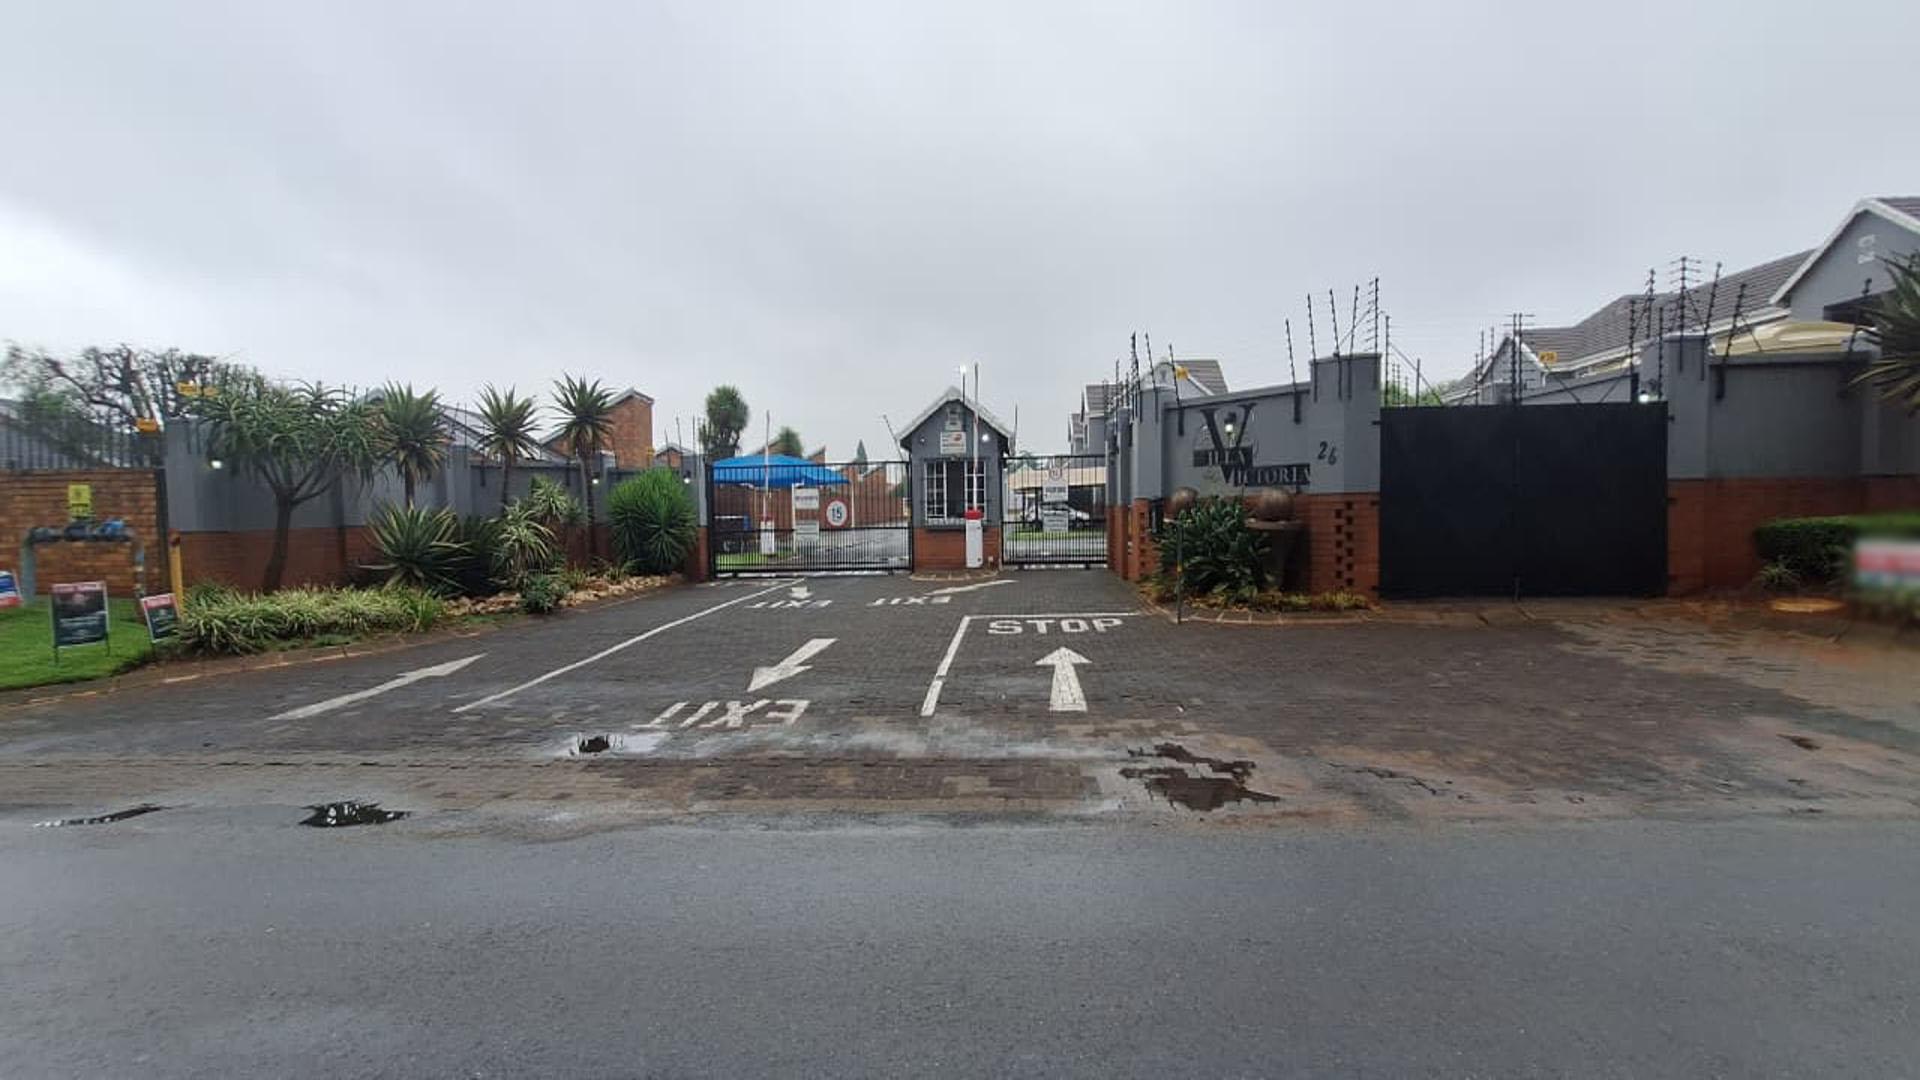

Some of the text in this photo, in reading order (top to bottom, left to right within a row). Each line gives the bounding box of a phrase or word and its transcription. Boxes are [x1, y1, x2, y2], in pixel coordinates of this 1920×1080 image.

[1317, 441, 1337, 466] 26
[1221, 464, 1311, 486] VICTORIA
[832, 505, 843, 519] 15
[988, 618, 1123, 634] STOP
[630, 700, 810, 728] EXIT
